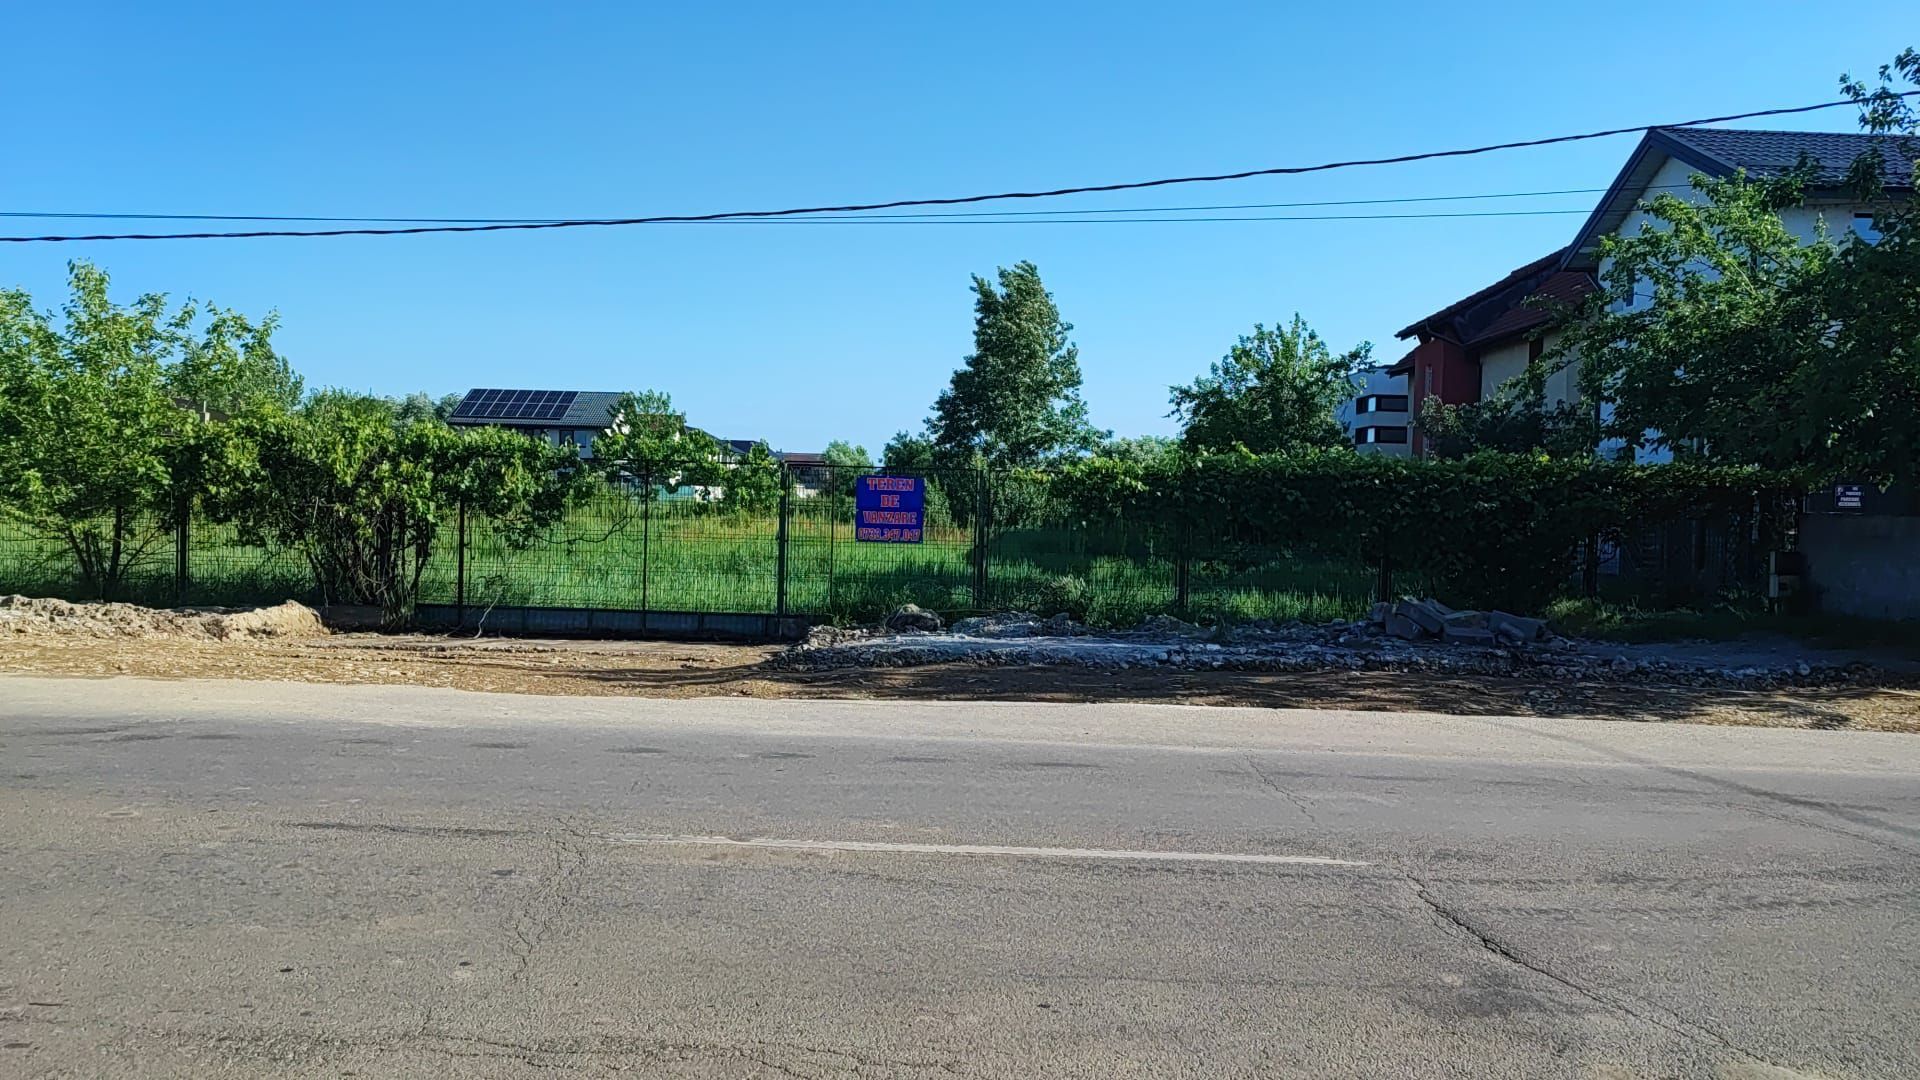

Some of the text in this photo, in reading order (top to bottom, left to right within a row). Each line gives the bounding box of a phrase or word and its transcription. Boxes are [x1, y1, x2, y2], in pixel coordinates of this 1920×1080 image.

[866, 477, 915, 491] TEREN
[880, 494, 900, 508] DE
[863, 510, 917, 525] VANZARE
